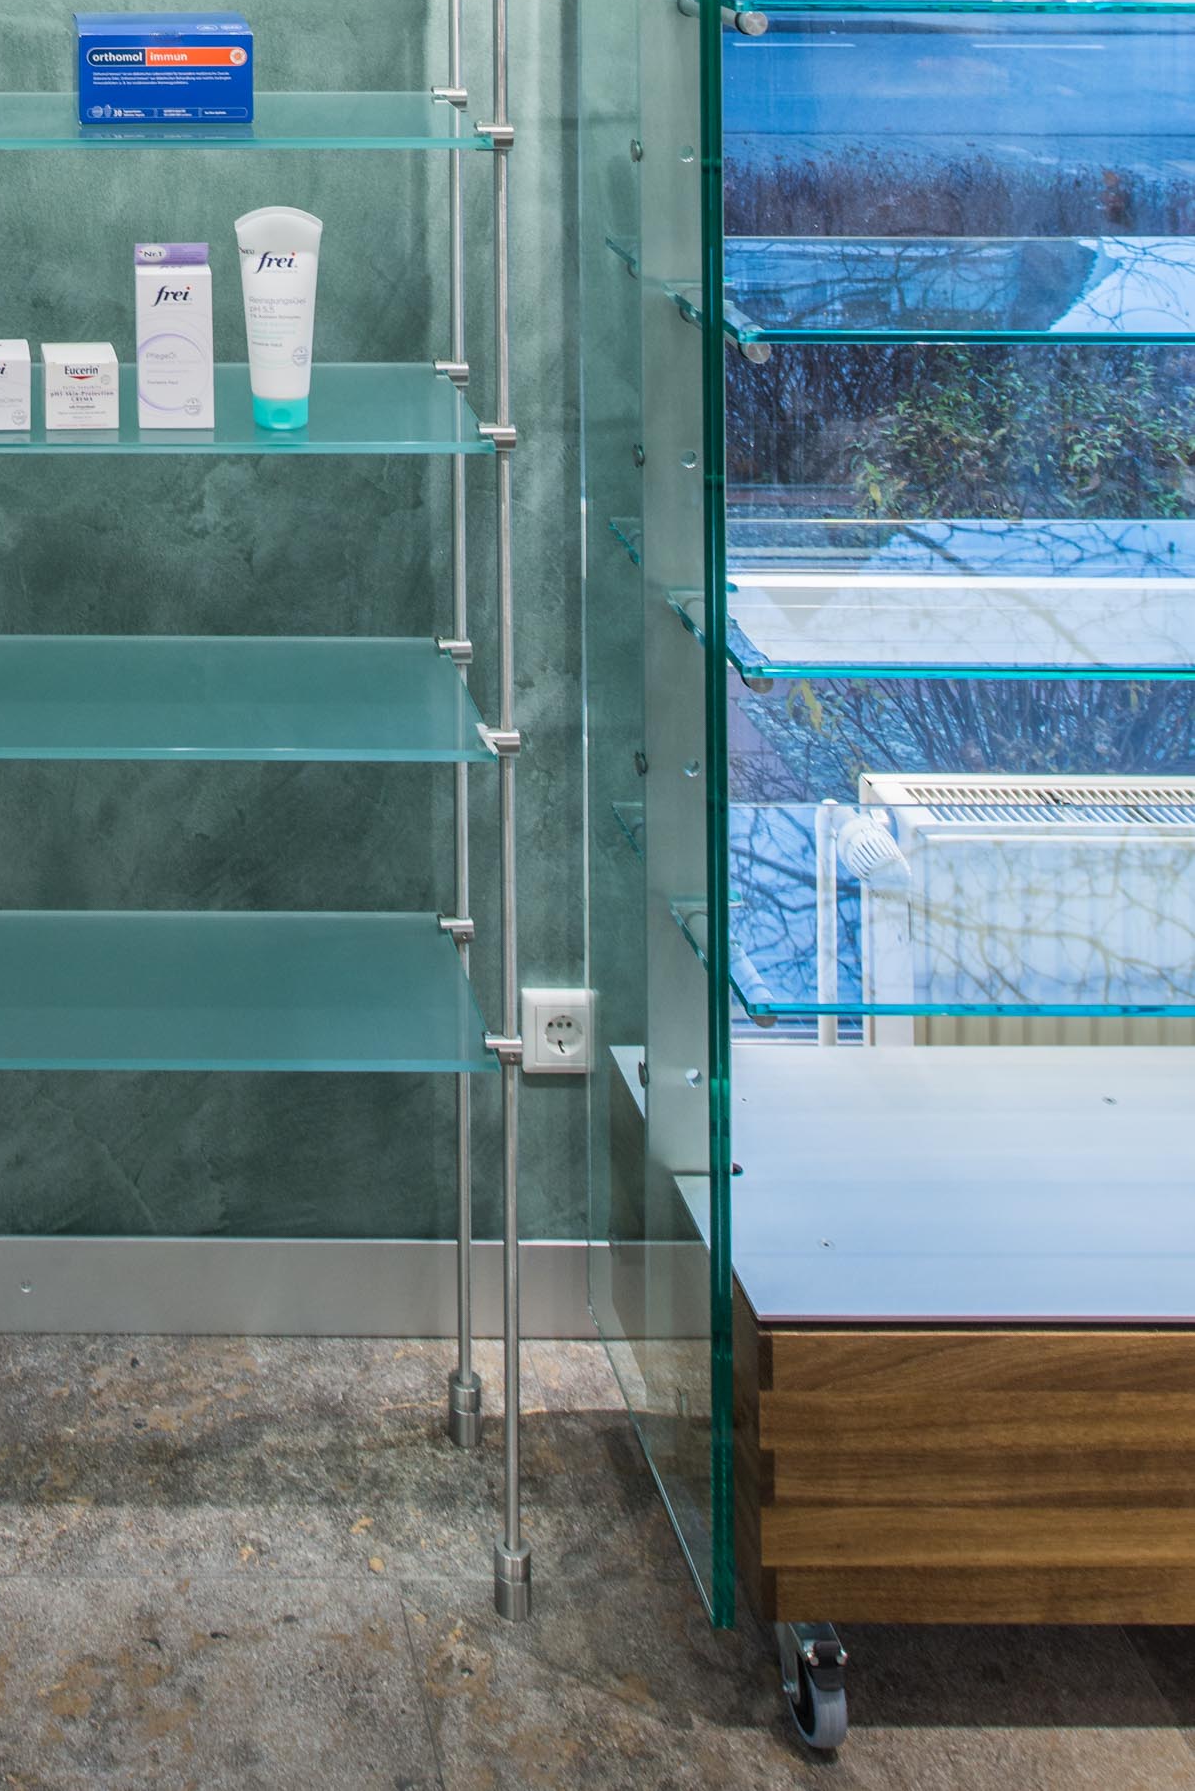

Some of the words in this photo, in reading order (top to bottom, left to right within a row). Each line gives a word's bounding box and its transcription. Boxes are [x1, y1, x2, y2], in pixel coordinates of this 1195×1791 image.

[92, 51, 143, 62] orthomol
[150, 51, 188, 61] immun
[253, 250, 297, 274] frei
[152, 285, 192, 307] frei
[64, 364, 99, 375] Eucerin
